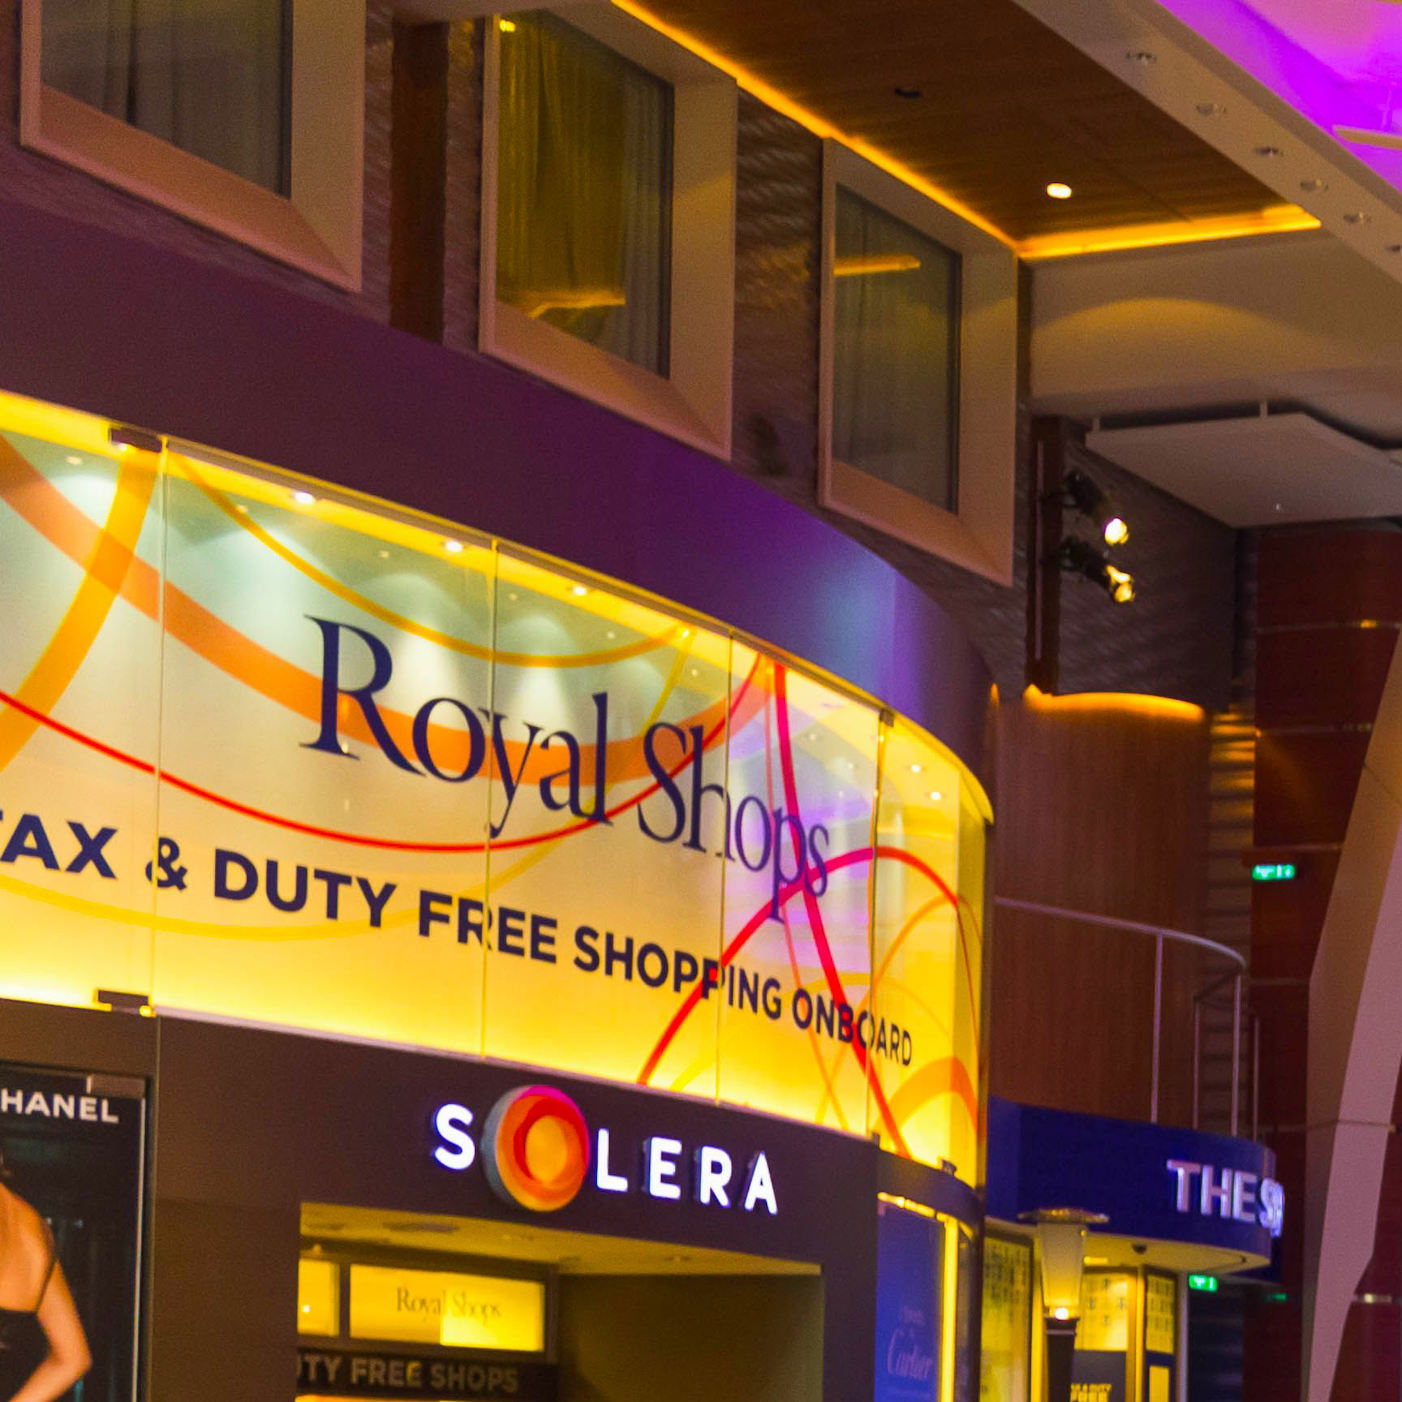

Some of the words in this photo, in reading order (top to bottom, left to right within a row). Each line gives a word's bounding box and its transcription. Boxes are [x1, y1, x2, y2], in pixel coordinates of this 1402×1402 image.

[299, 615, 613, 839] Royal
[637, 721, 830, 923] Shops
[0, 809, 118, 880] AX
[145, 837, 188, 891] &
[214, 848, 397, 928] DUTY
[418, 889, 558, 964] FREE
[573, 925, 782, 1020] SHOPPING
[792, 987, 912, 1067] ONBOARD
[432, 1084, 778, 1216] SOLERA
[396, 1286, 446, 1322] Royal
[352, 1358, 422, 1388] FREE
[430, 1363, 519, 1393] SHOPS
